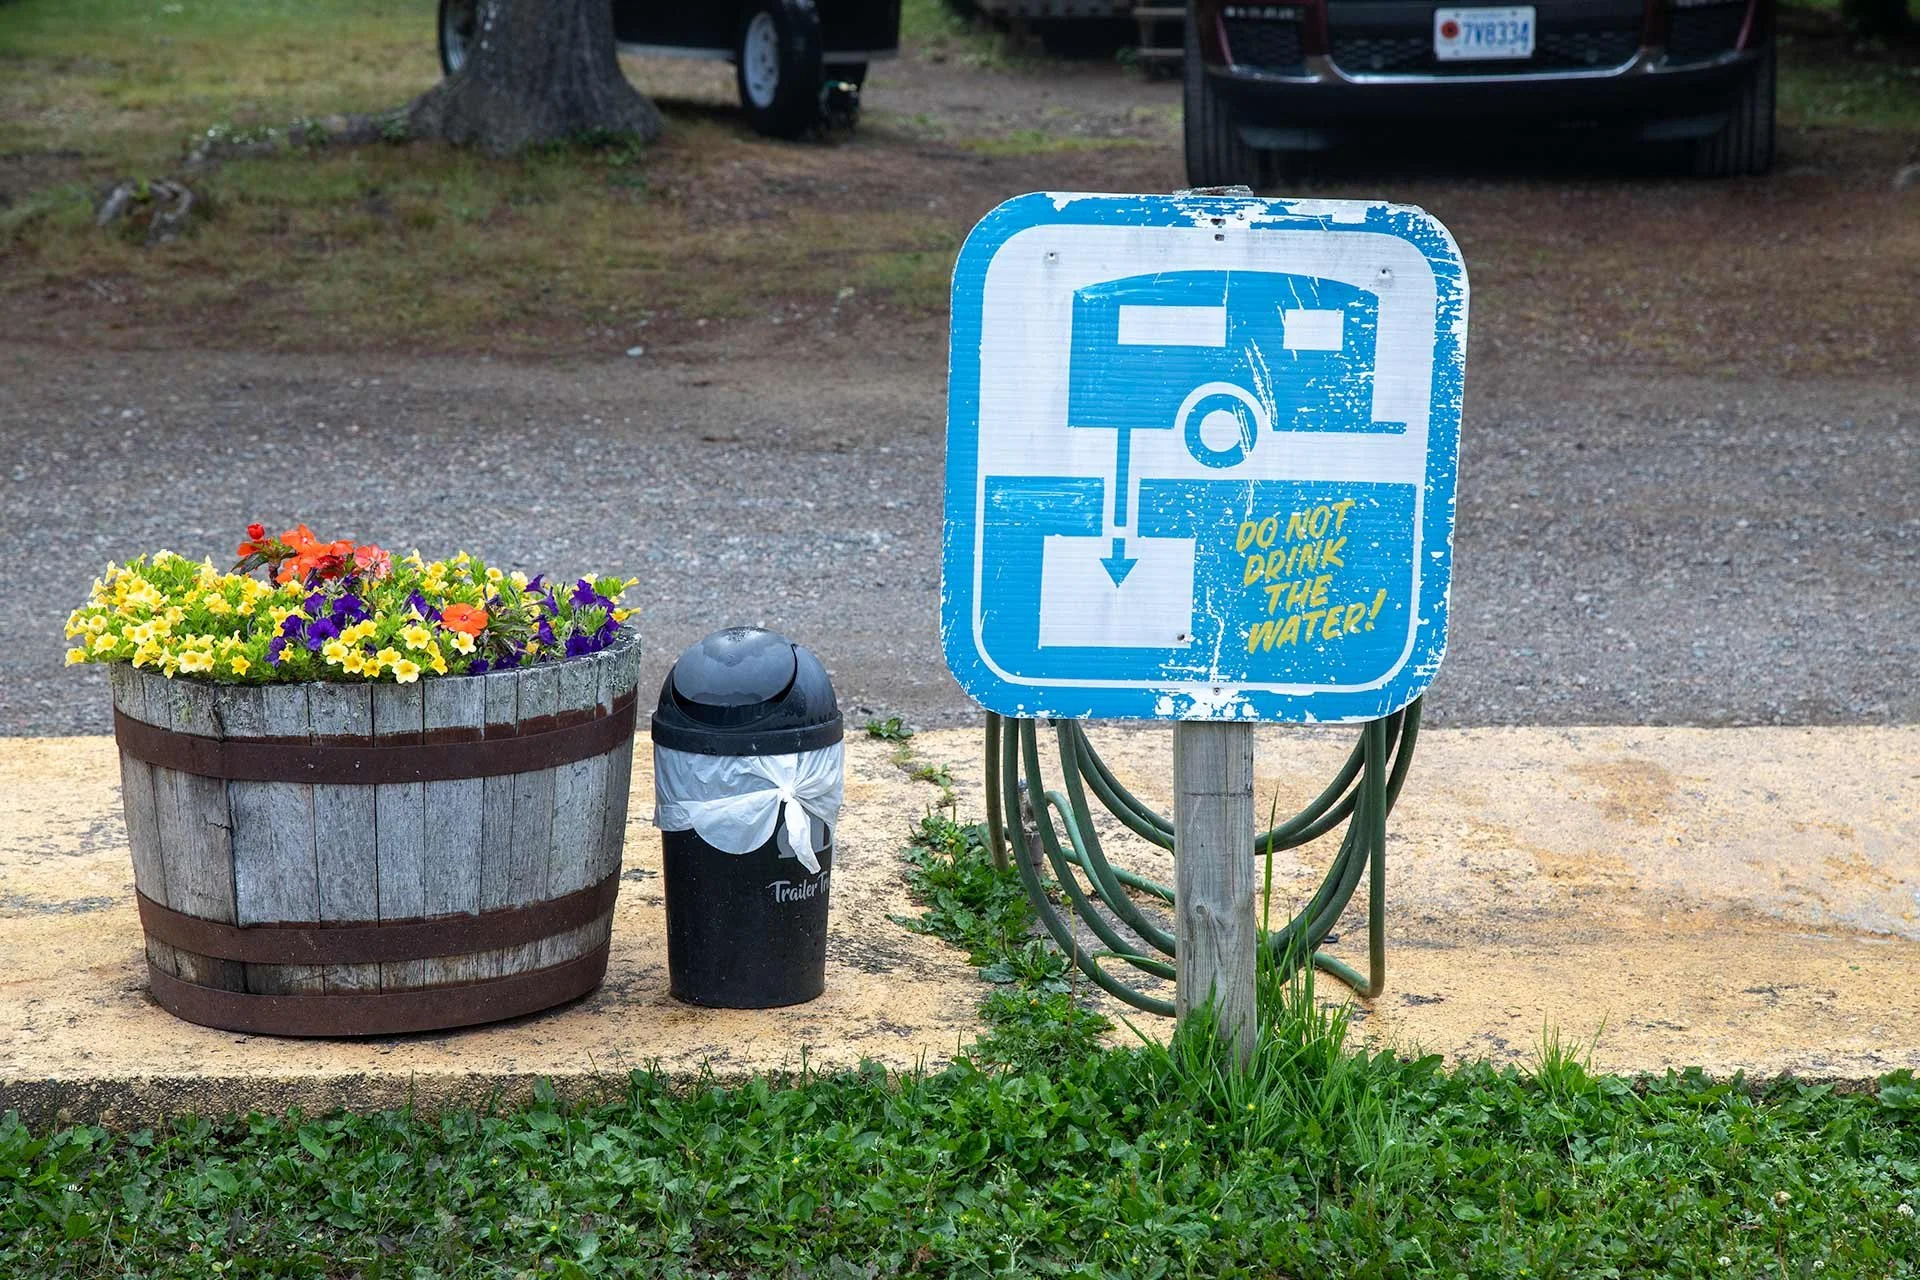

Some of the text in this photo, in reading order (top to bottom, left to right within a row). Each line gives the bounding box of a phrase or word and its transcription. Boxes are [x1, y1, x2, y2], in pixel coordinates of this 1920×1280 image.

[1236, 500, 1355, 552] DO NOT
[1243, 536, 1348, 587] DRINK
[1264, 573, 1334, 616] THE
[1247, 588, 1388, 654] WATER!
[765, 880, 817, 903] Trailer
